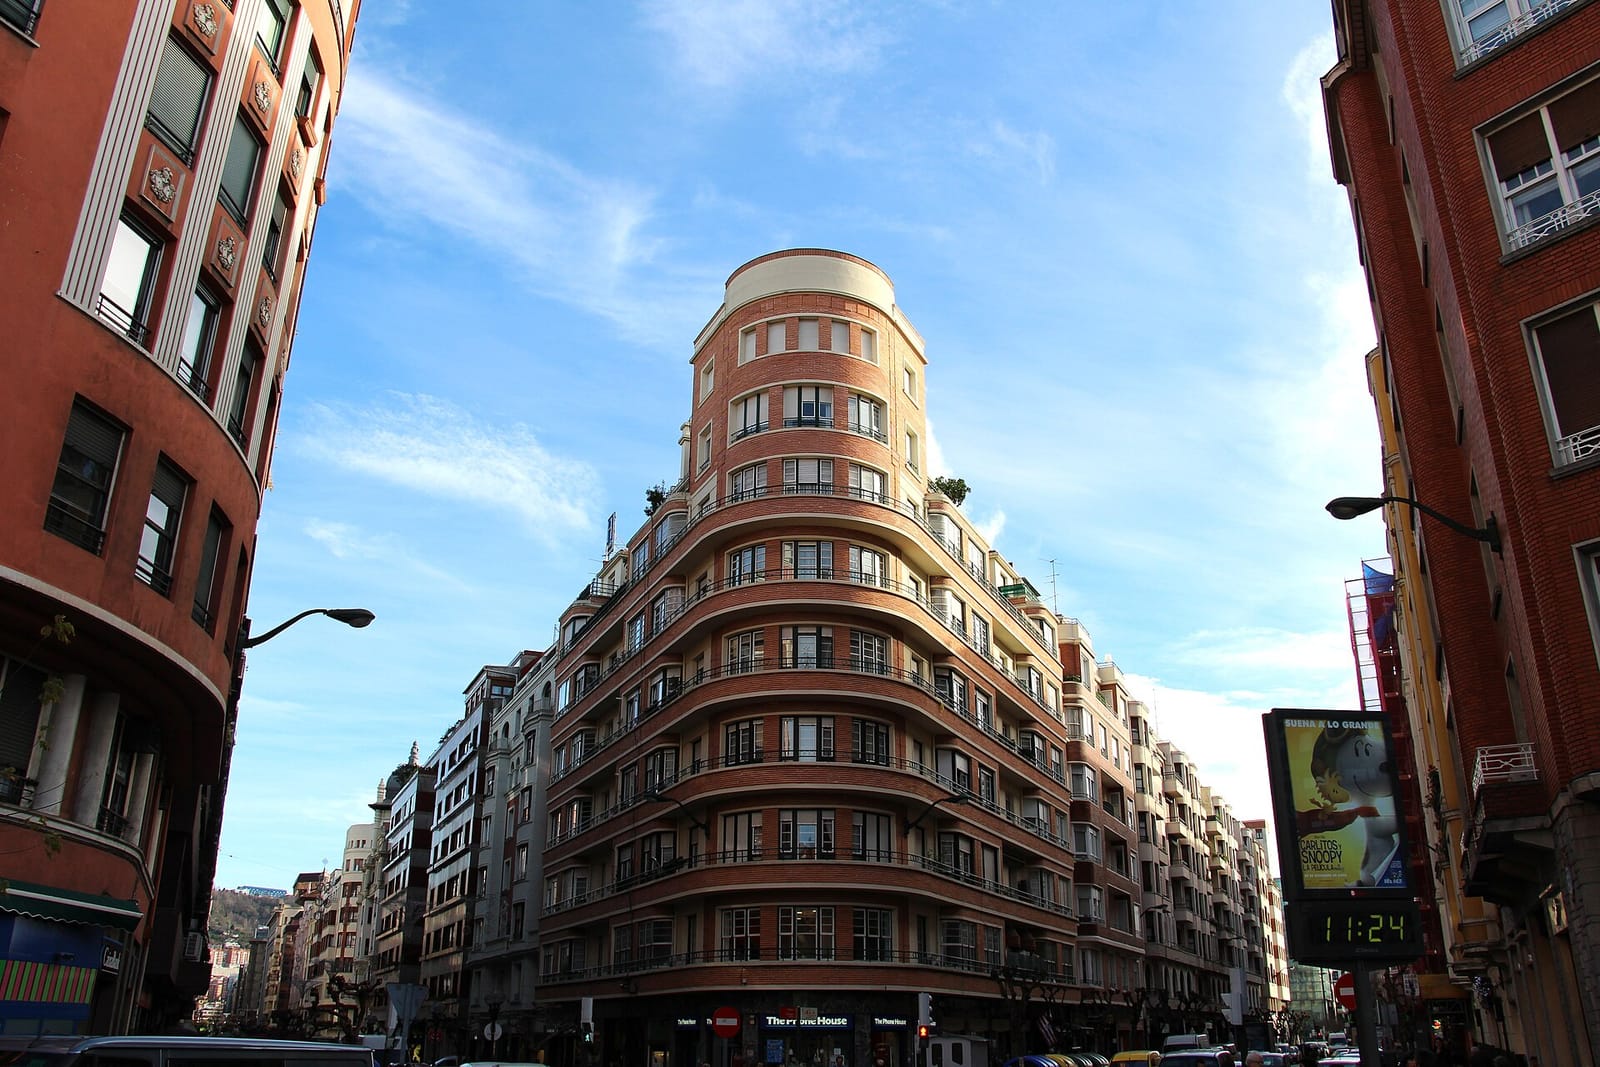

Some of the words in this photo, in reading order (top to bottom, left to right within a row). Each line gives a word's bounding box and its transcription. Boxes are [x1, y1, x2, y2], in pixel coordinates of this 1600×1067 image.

[1327, 720, 1339, 728] LO
[1342, 721, 1380, 729] GRANDE
[1301, 850, 1342, 863] SNOOPY
[1326, 914, 1404, 943] 11:24
[766, 1016, 785, 1025] The
[817, 1016, 848, 1025] House
